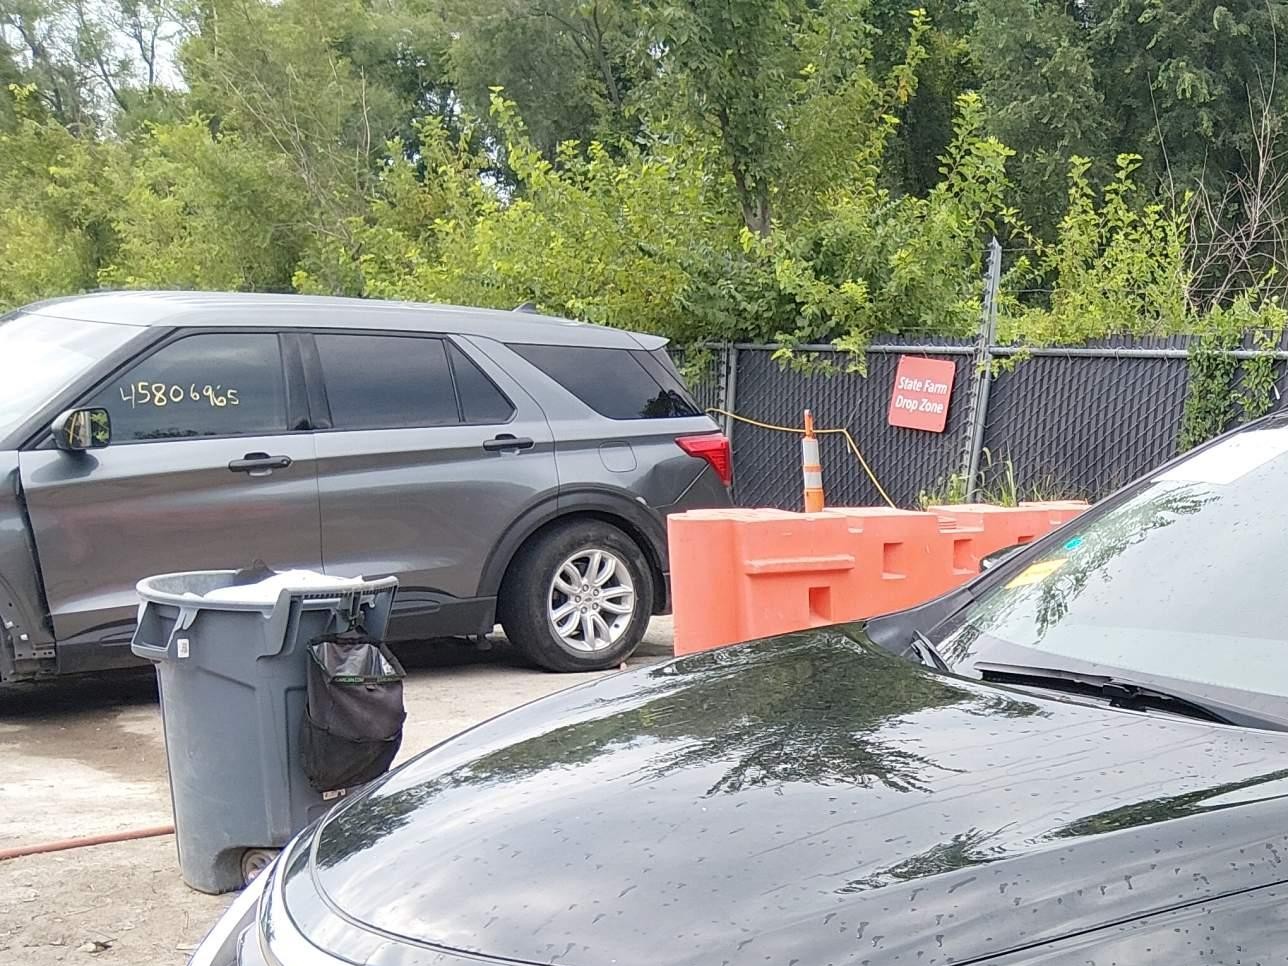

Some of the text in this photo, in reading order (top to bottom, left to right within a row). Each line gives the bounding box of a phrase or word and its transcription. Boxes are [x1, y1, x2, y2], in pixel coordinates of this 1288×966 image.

[898, 377, 948, 394] State Farm
[120, 382, 239, 408] 45806965
[895, 395, 944, 413] Drop Zone
